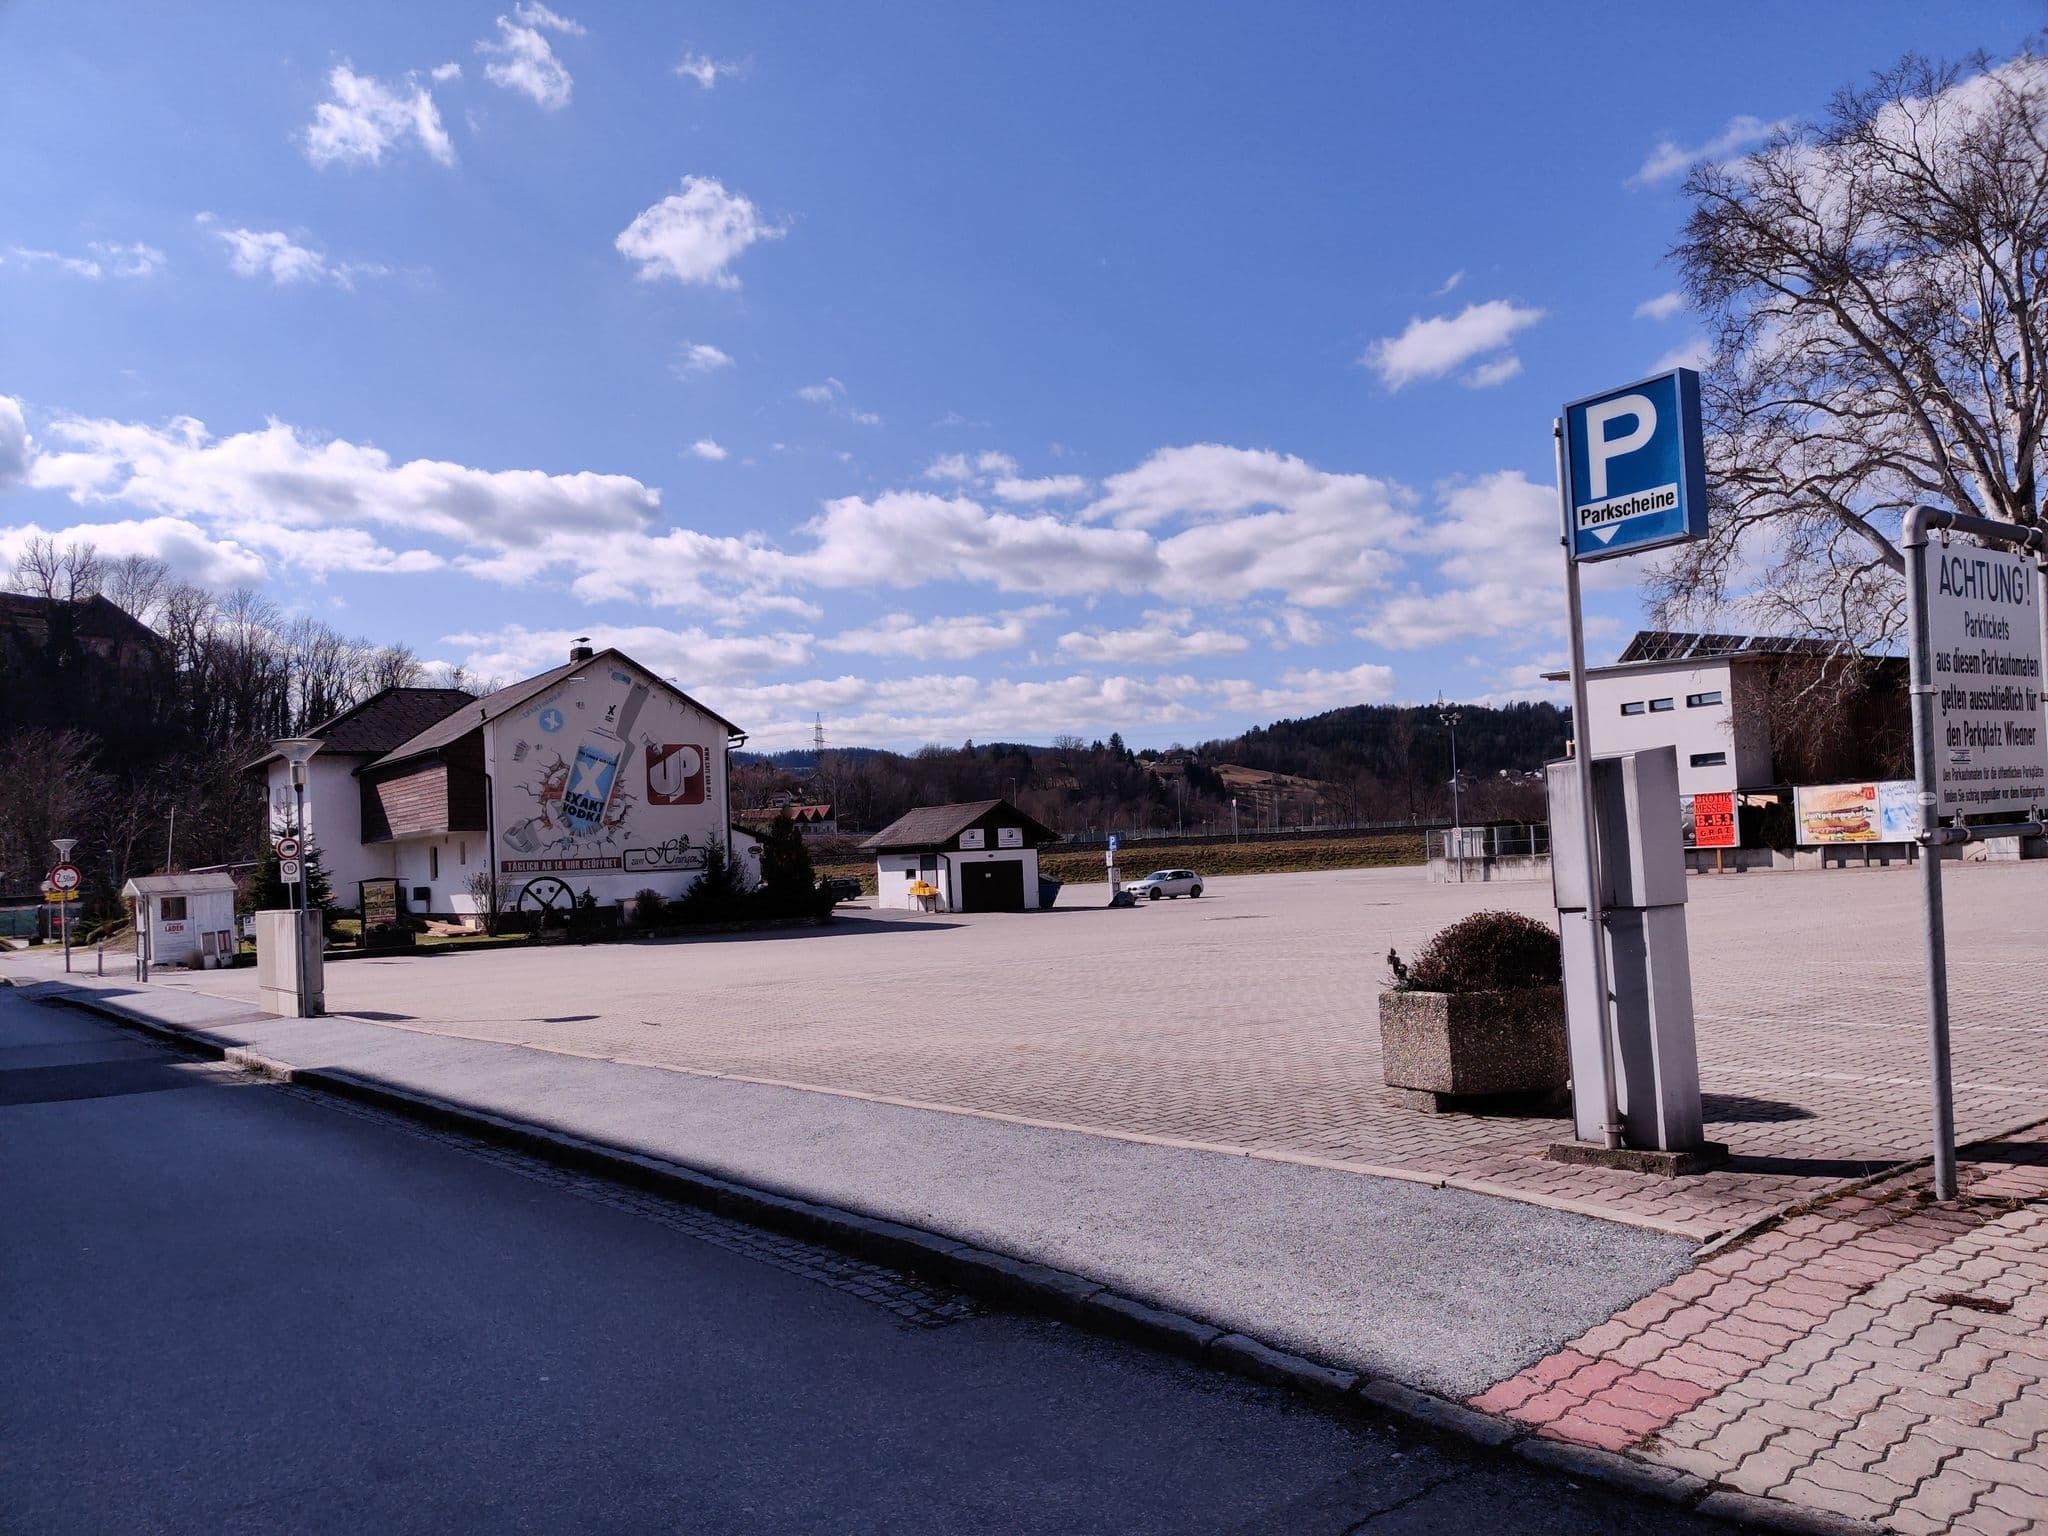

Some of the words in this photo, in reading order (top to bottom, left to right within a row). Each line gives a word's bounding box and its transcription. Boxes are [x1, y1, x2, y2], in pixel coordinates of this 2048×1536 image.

[1586, 394, 1657, 500] P
[1581, 490, 1675, 526] Parkscheine
[1939, 554, 2031, 606] ACHTUNG!
[1964, 611, 2010, 640] Parktickets
[1936, 651, 1951, 673] aus
[1953, 646, 1981, 675] diesem
[1982, 649, 2039, 677] Parkautomaten
[1941, 683, 1967, 716] gelten
[1969, 685, 2024, 712] ausschließlich
[2026, 687, 2038, 712] für
[1946, 720, 1962, 746] den
[1964, 720, 2003, 753] Parkplatz
[575, 759, 604, 800] X
[562, 802, 602, 823] VODKA
[565, 790, 606, 813] EXAKT
[1695, 793, 1731, 804] EROTIK
[1695, 803, 1721, 813] MESSE
